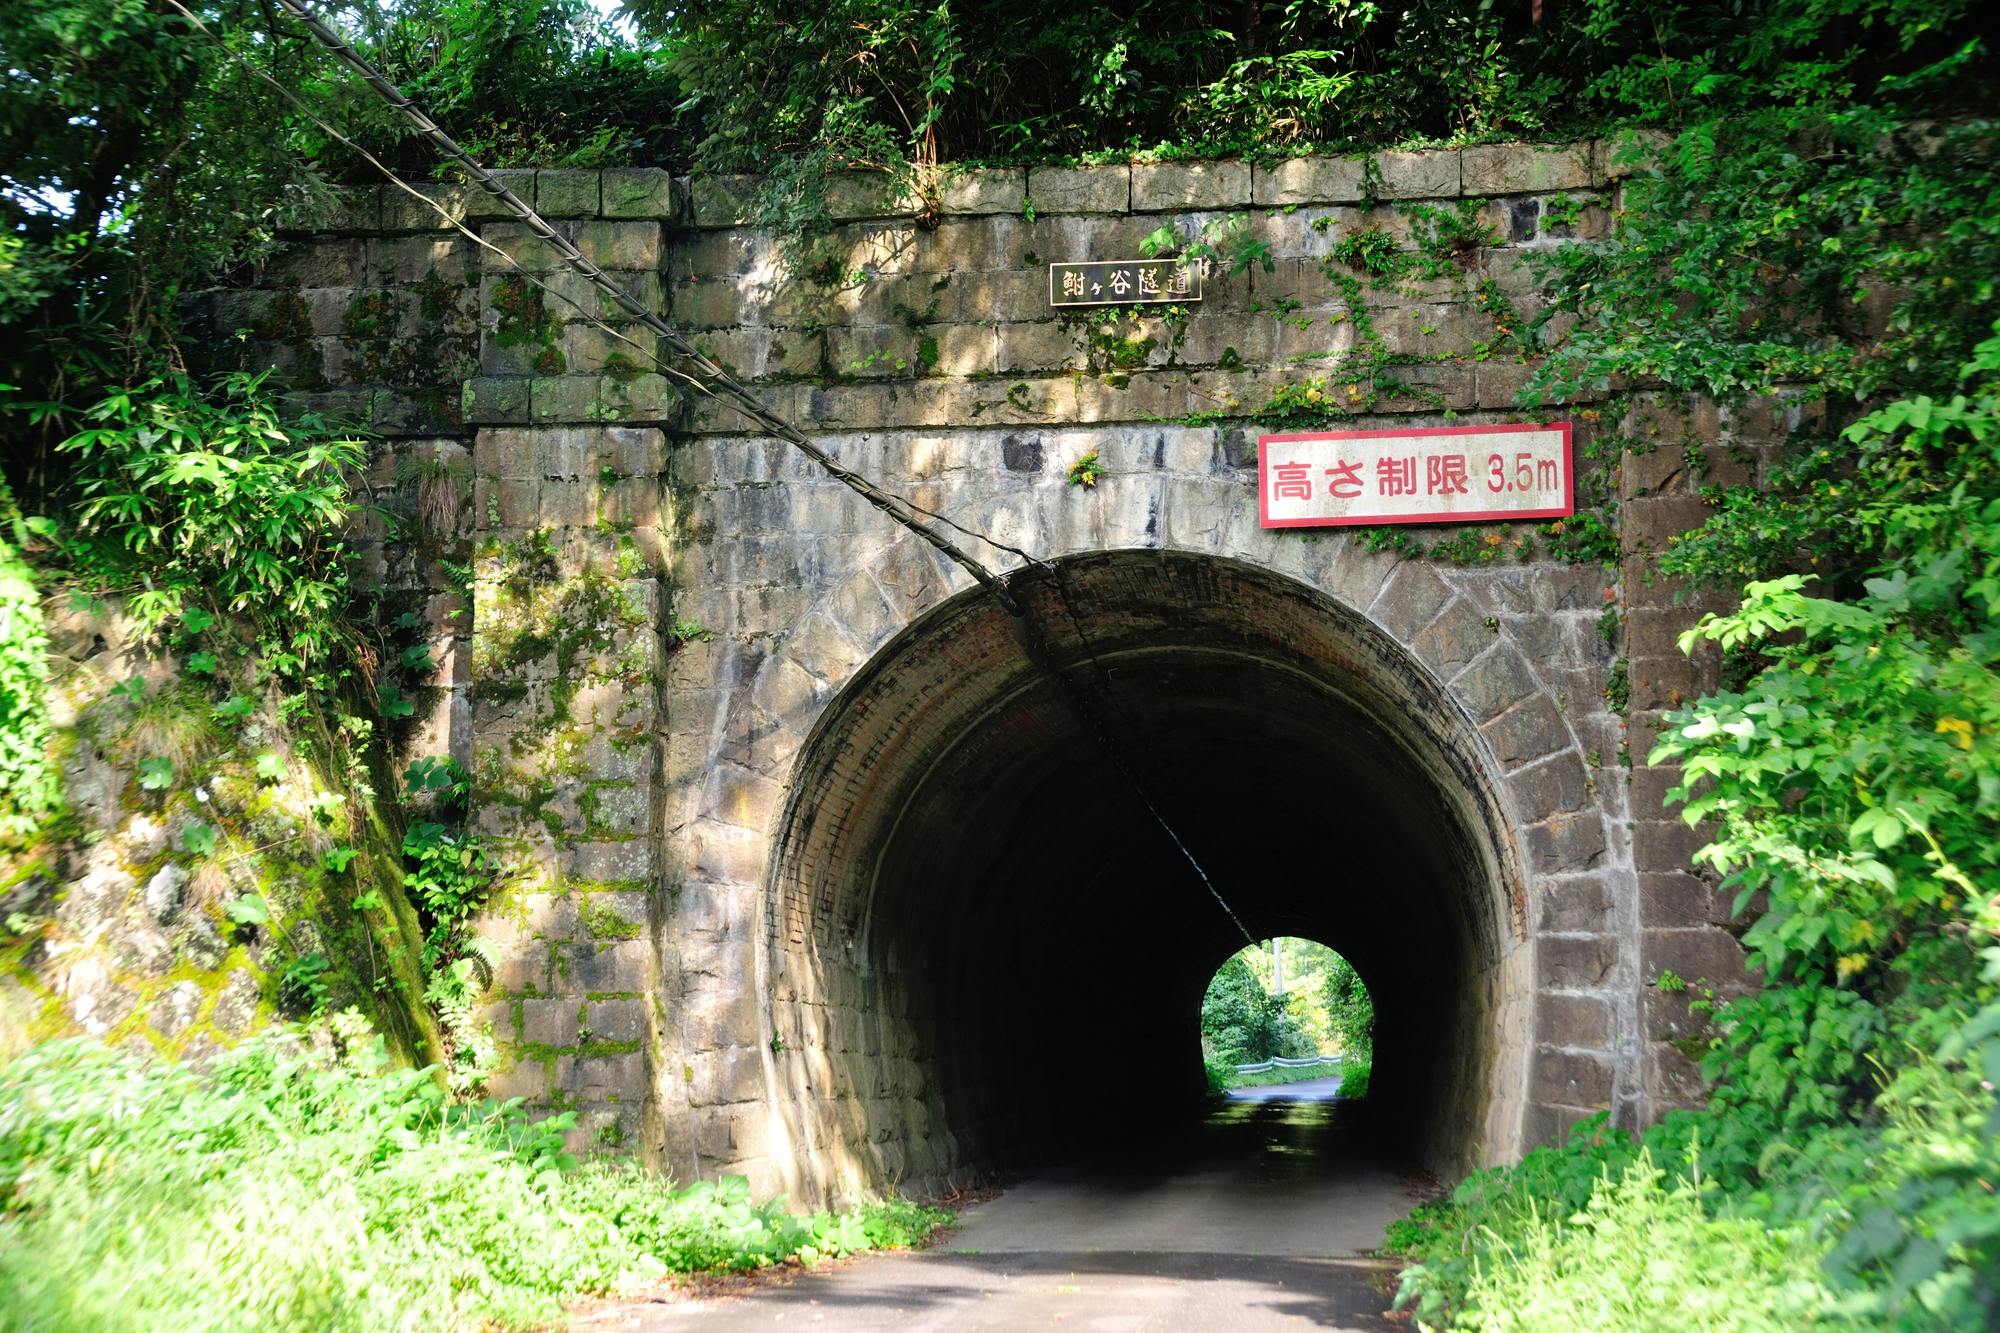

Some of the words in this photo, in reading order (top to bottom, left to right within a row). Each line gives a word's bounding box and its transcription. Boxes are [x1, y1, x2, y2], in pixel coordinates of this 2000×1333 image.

[1273, 454, 1468, 501] 高さ制限
[1487, 452, 1558, 493] 3.5m
